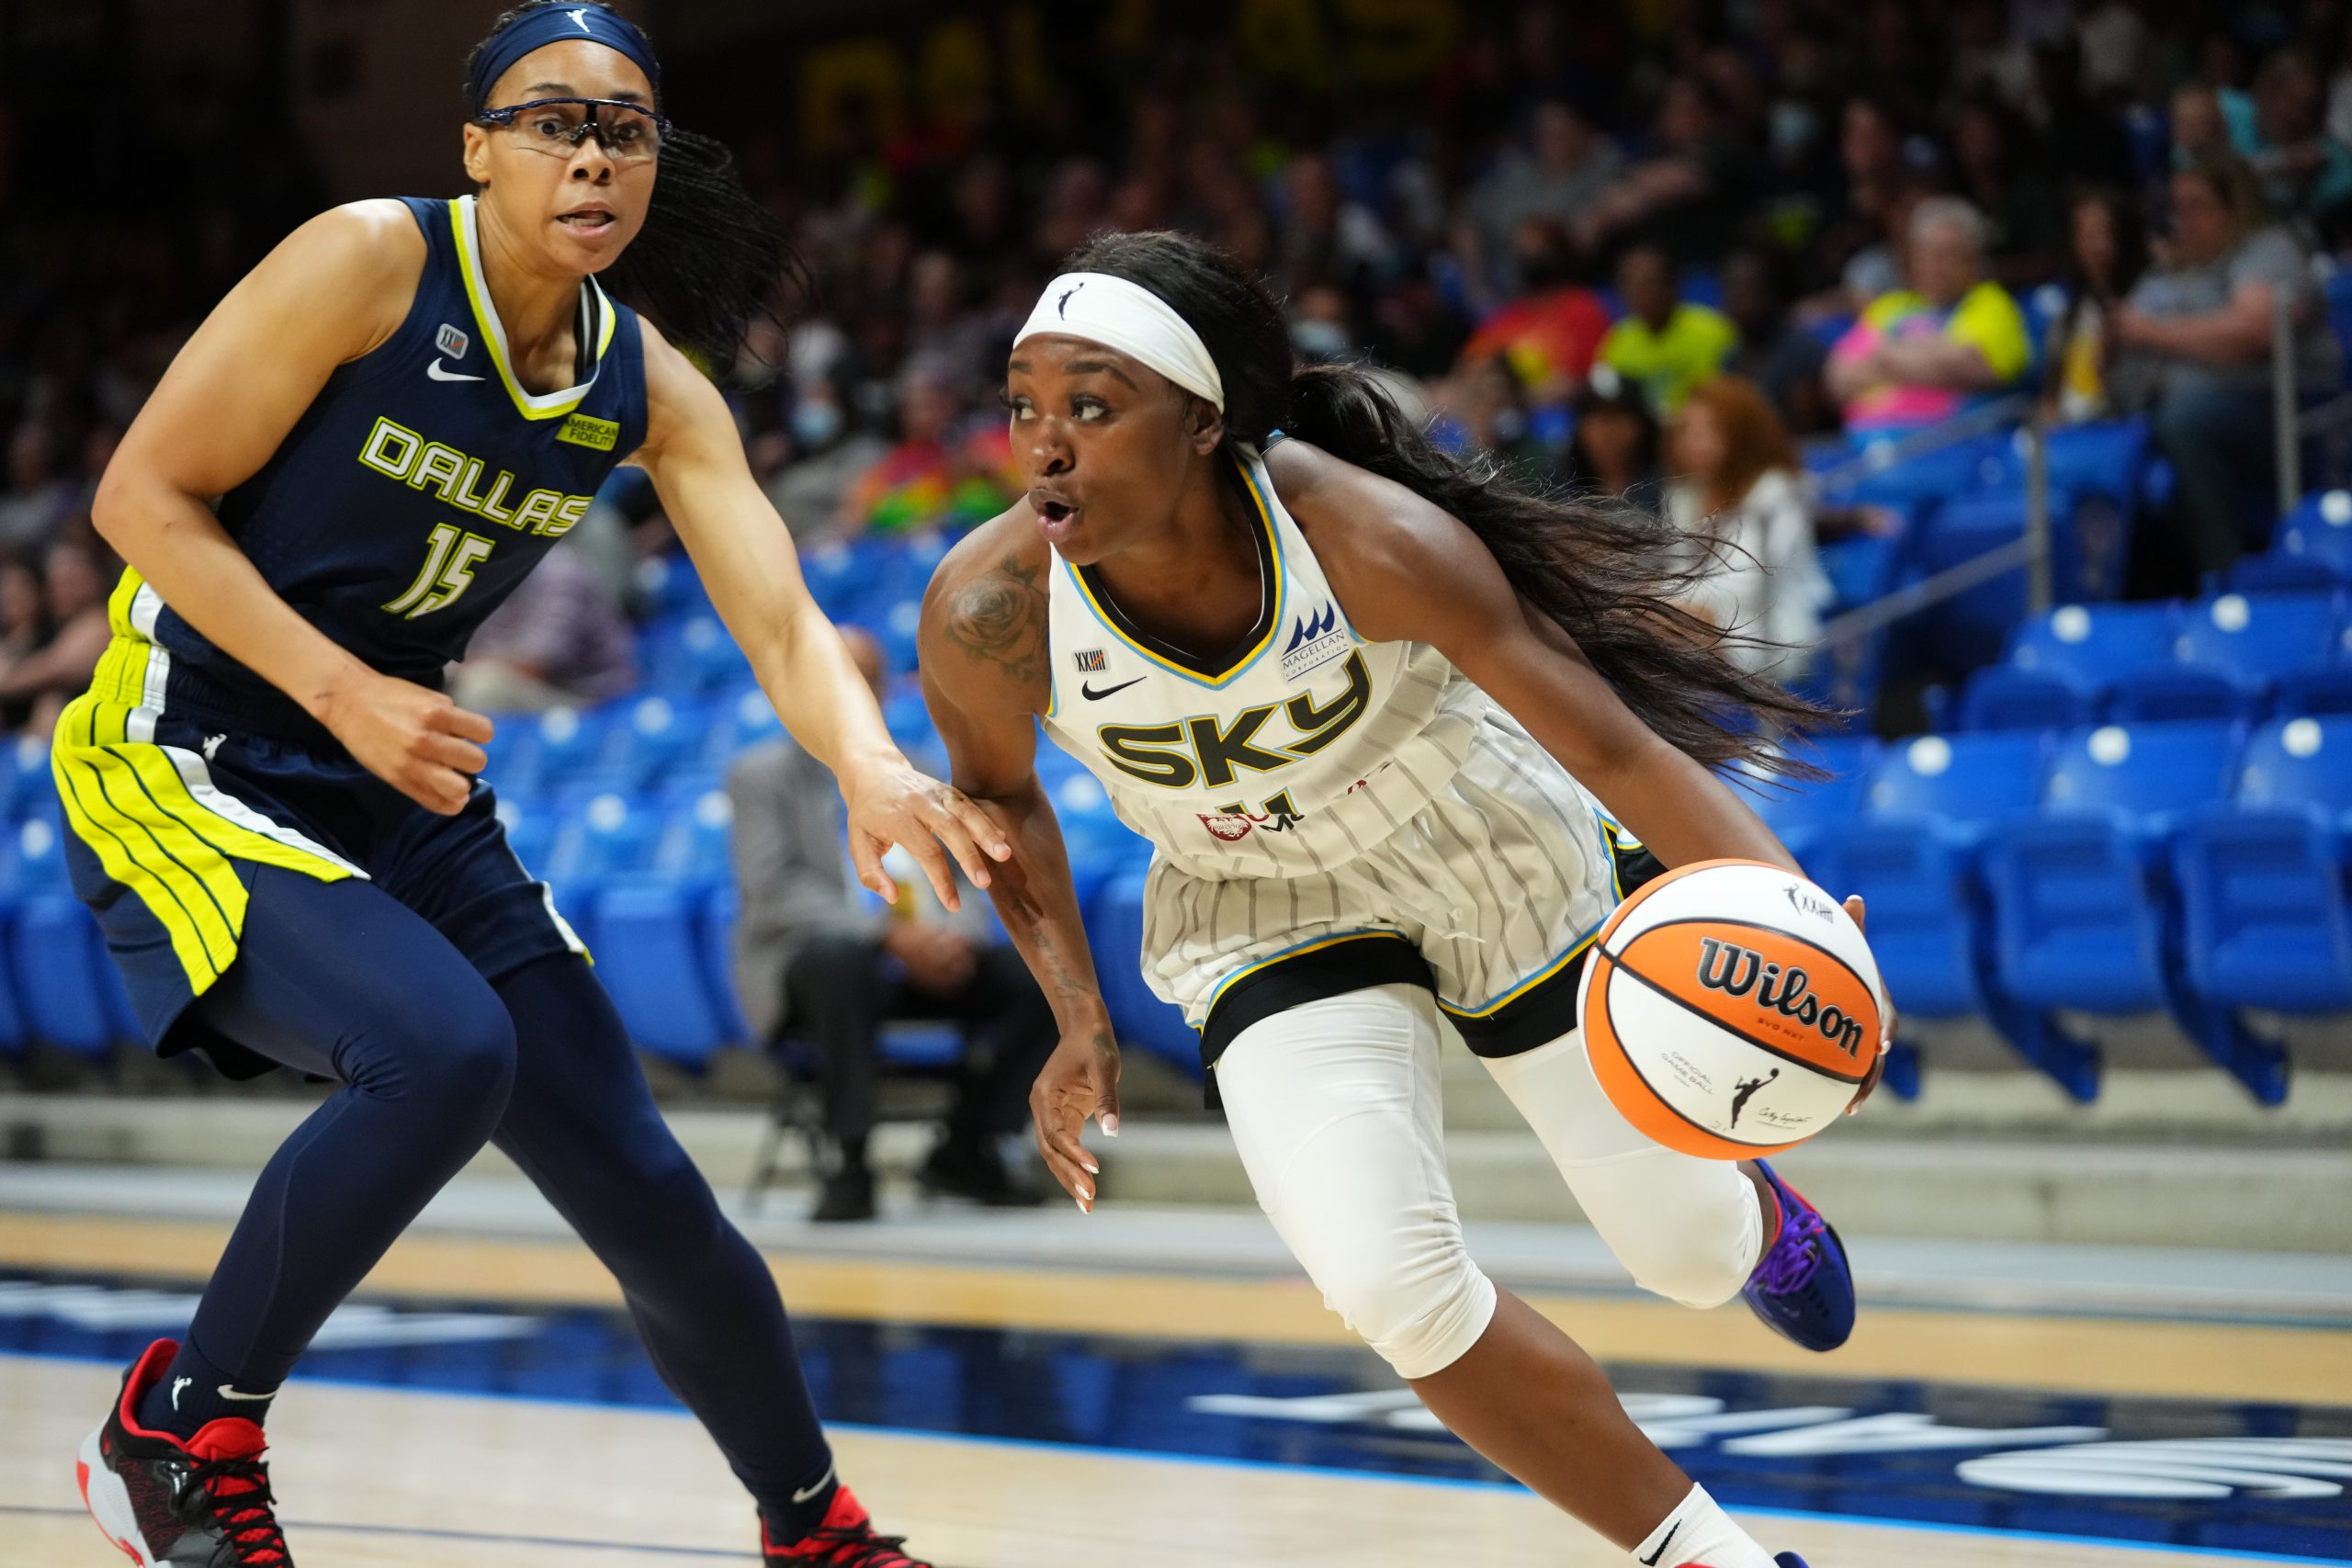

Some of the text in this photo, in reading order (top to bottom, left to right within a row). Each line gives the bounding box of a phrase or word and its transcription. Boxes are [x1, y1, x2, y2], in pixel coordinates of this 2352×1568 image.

[567, 418, 617, 436] AMERICAN
[570, 427, 614, 446] FIDELITY
[357, 415, 594, 537] DALLAS
[380, 522, 496, 620] 15
[1282, 631, 1345, 671] MAGELLAN
[1285, 643, 1348, 677] CORPORATION
[1097, 647, 1372, 790] SKY
[1698, 936, 1865, 1059] Wilson
[1660, 1053, 1688, 1077] GAME
[1689, 1076, 1713, 1095] BALL
[1670, 1051, 1713, 1086] OFFICIAL
